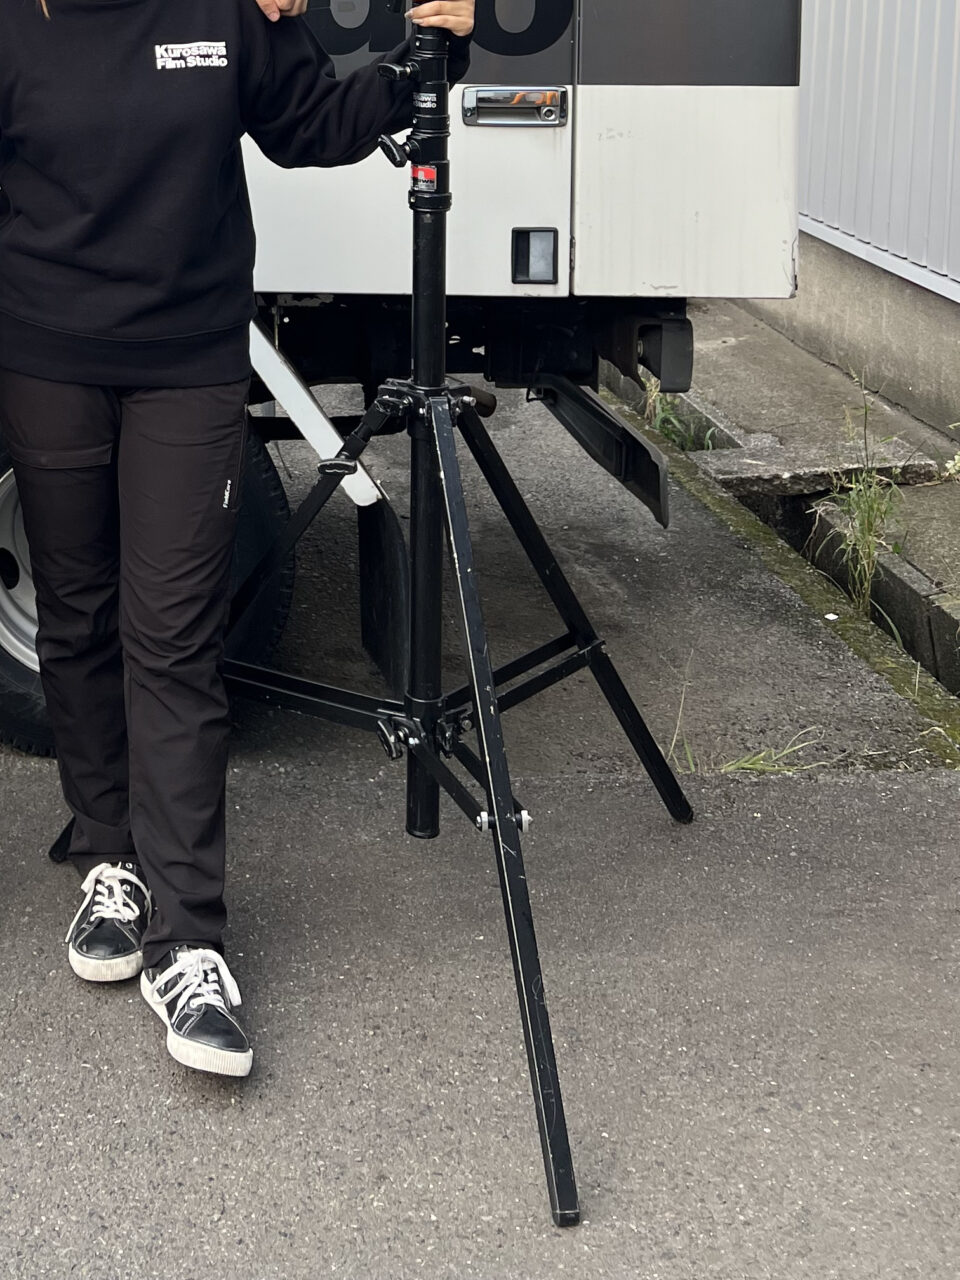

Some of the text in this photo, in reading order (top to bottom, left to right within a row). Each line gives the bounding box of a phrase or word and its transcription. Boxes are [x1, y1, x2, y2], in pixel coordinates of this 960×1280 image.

[155, 44, 227, 58] Kurosawa
[156, 55, 228, 70] Film Studio
